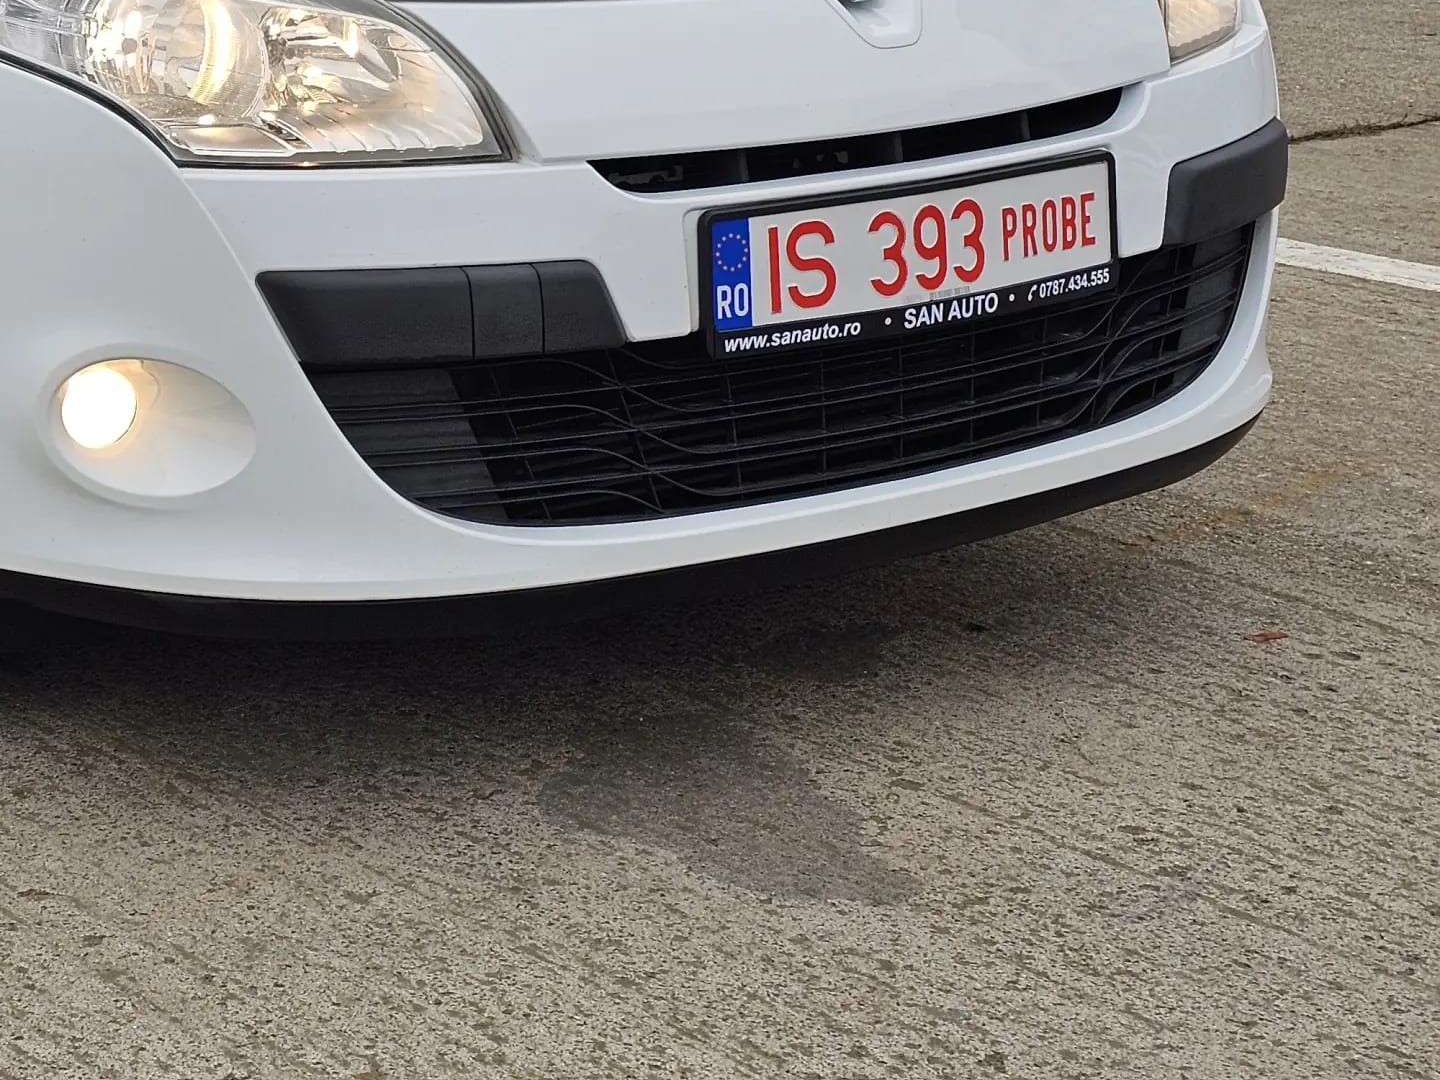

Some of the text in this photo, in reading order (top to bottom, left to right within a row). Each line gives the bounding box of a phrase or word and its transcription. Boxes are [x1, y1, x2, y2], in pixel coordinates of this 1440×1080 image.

[767, 192, 1096, 314] IS 393 PROBE
[716, 282, 749, 320] RO
[724, 321, 861, 353] www.sanauto.ro
[903, 302, 944, 329] SAN
[948, 292, 999, 320] AUTO
[1039, 268, 1110, 299] 0787.434.555
